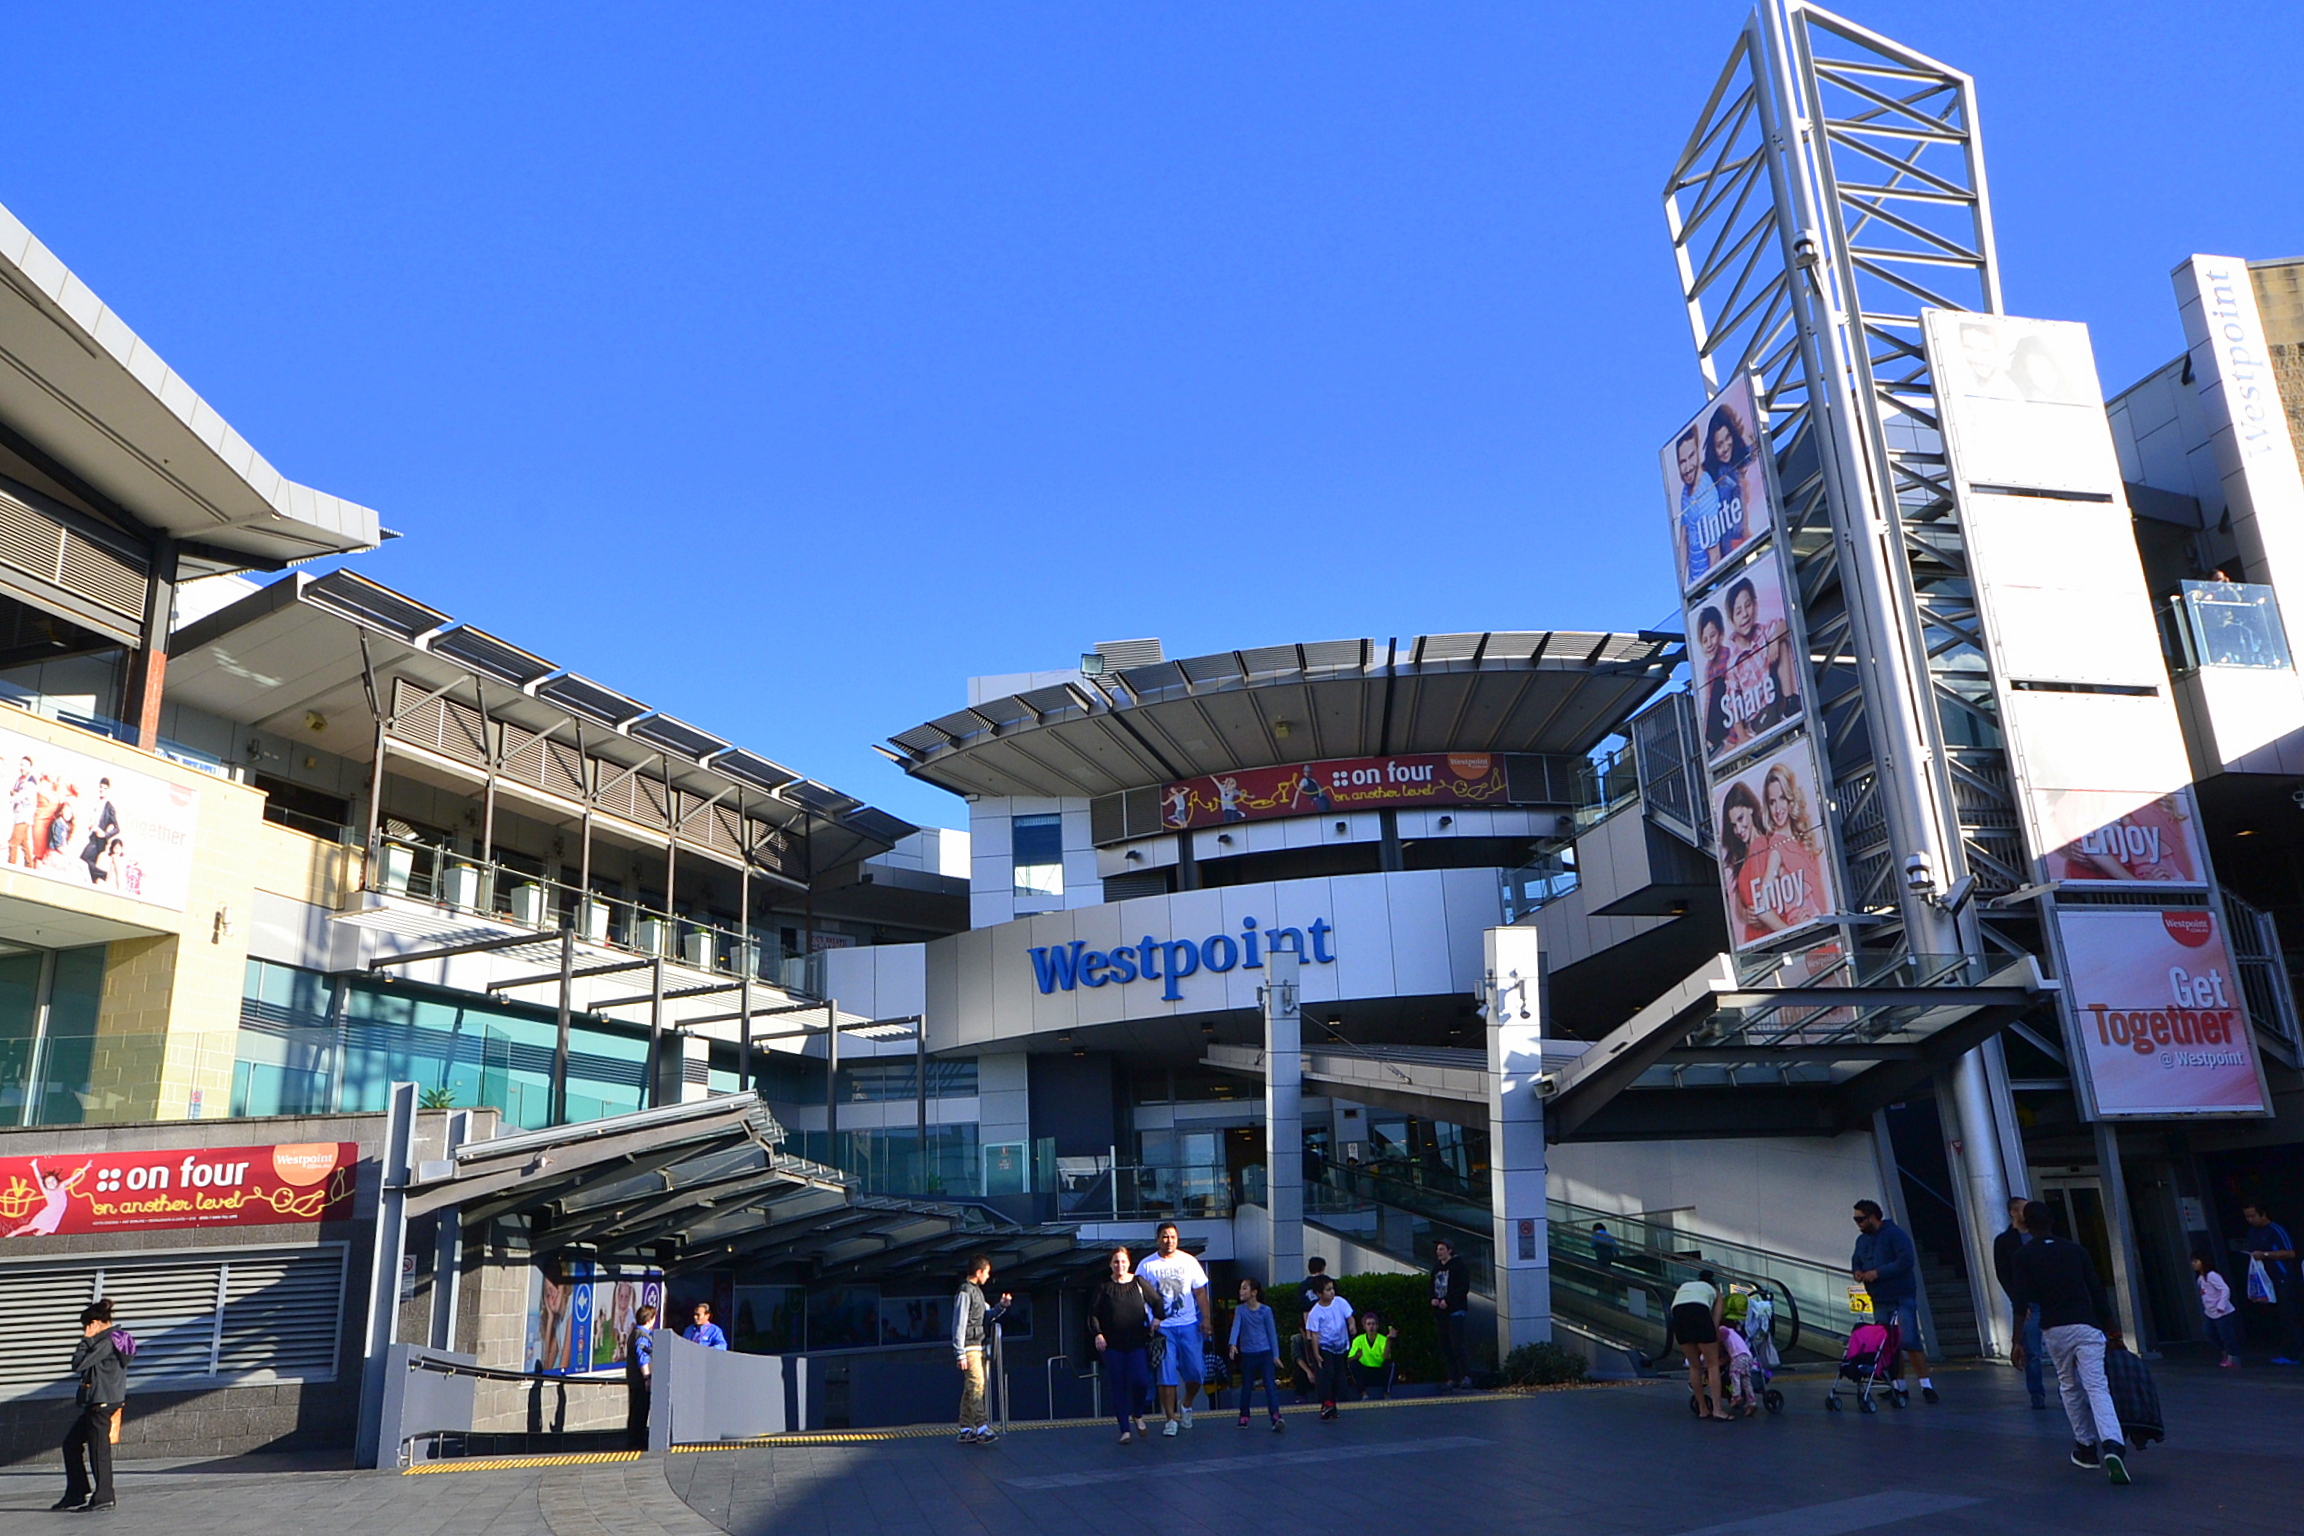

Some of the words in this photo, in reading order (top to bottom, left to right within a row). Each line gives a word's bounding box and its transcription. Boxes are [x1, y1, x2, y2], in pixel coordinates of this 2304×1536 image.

[1696, 496, 1743, 550] Unite
[1720, 675, 1776, 729] Share
[1352, 767, 1381, 785] on
[1387, 761, 1434, 783] four
[1450, 757, 1488, 768] Westpoint
[1333, 792, 1351, 802] on
[1352, 786, 1401, 800] another
[1402, 784, 1436, 797] level
[2081, 817, 2160, 864] Enjoy
[1750, 869, 1804, 915] Enjoy
[2165, 918, 2209, 931] Westpoint
[1027, 916, 1336, 1001] Westpoint
[2169, 966, 2230, 1009] Get
[2088, 1003, 2235, 1055] Together
[2159, 1054, 2174, 1068] @
[2175, 1050, 2245, 1069] Westpoint
[126, 1165, 169, 1191] on
[180, 1156, 250, 1188] four
[276, 1152, 333, 1169] Westpoint
[92, 1201, 117, 1215] on
[119, 1193, 193, 1214] another
[195, 1191, 244, 1210] level
